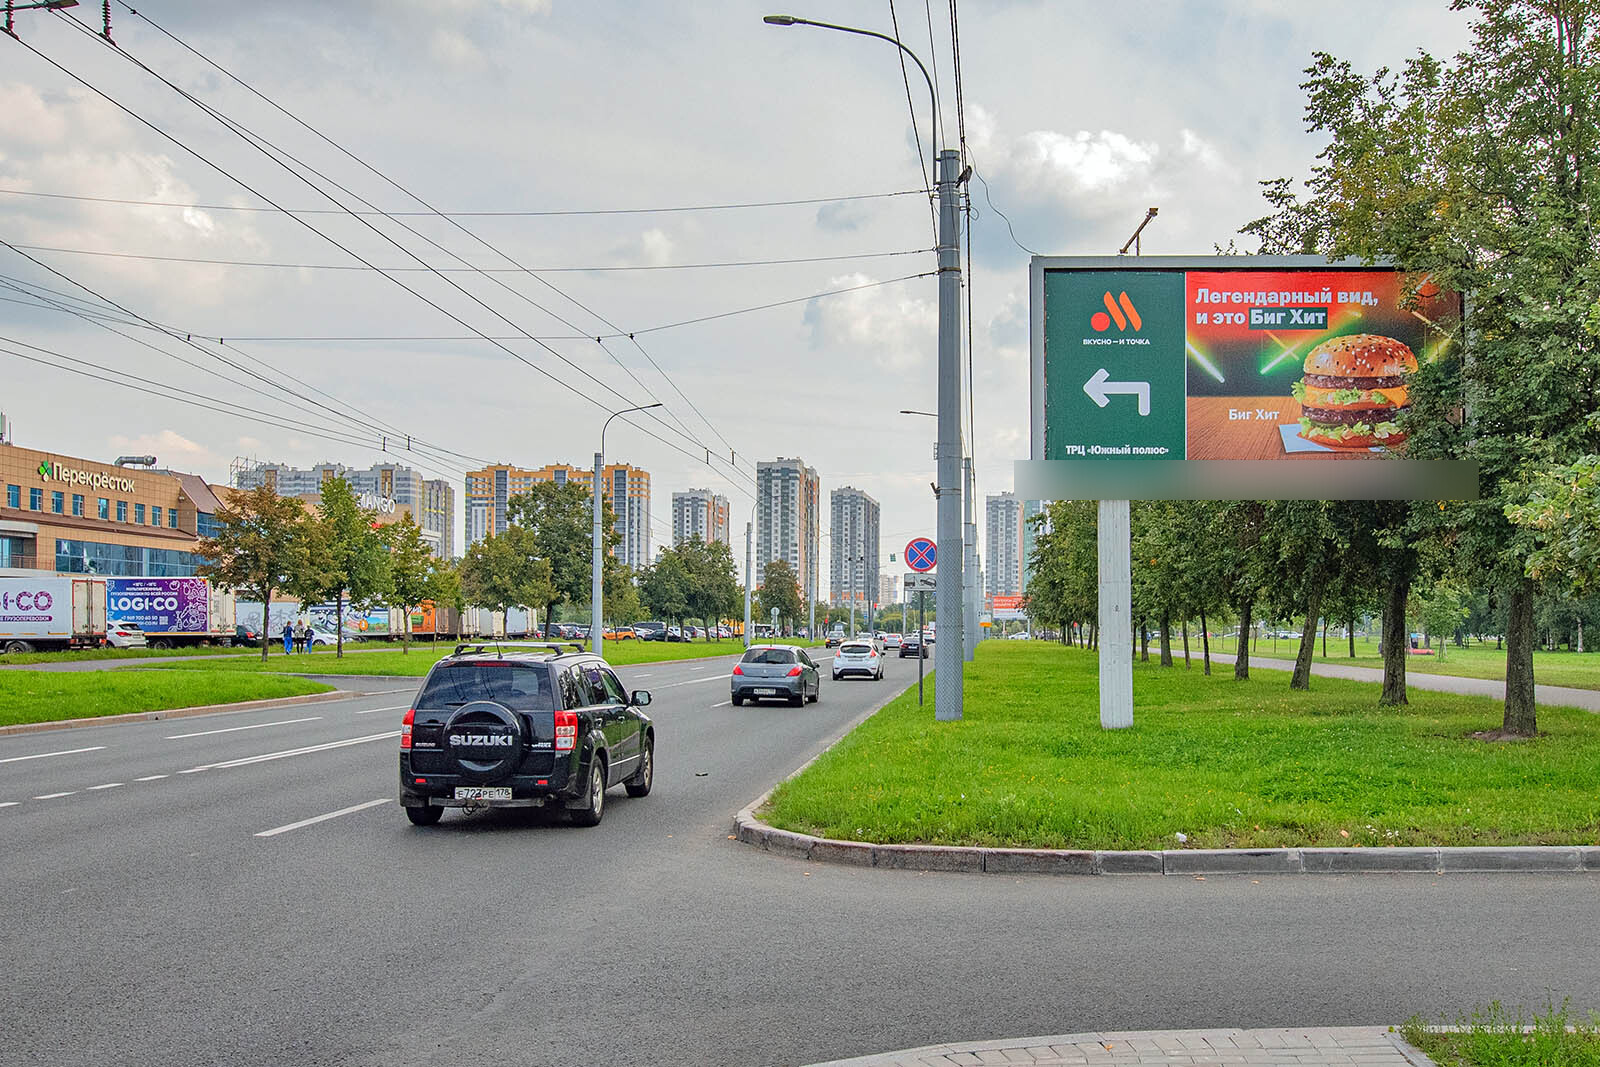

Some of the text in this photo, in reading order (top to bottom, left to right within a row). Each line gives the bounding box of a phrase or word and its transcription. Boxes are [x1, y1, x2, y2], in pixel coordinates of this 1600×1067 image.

[1195, 287, 1379, 306] Легендарный вид,
[1195, 309, 1327, 325] и это Биг Хит
[1229, 408, 1280, 421] Биг Хит
[1065, 444, 1169, 456] ТРЦ «Южный полюс»
[53, 462, 135, 493] Перекрёсток
[0, 591, 53, 611] I-CO
[450, 735, 513, 746] SUZUKI
